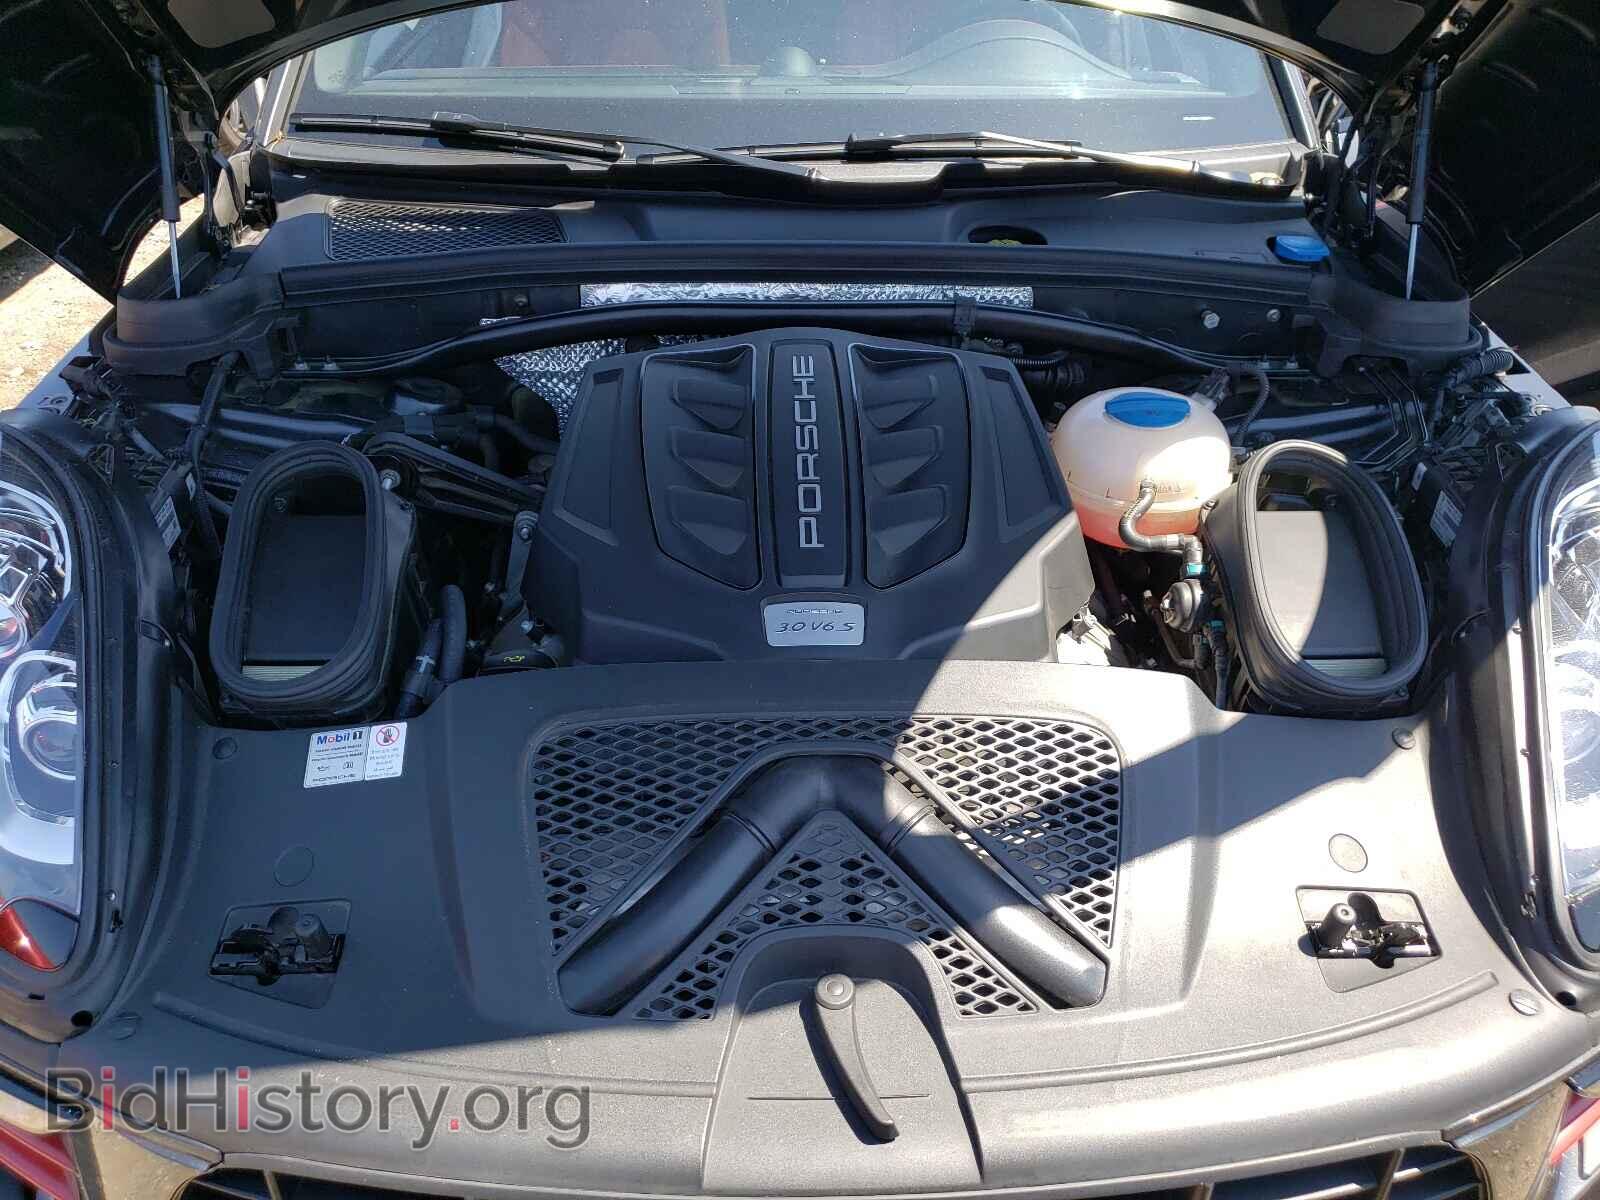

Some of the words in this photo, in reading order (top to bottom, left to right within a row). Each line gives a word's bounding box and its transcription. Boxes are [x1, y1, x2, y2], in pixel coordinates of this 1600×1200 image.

[792, 354, 824, 548] PORSCHE
[776, 622, 806, 633] 3.0
[811, 622, 834, 632] V6
[836, 622, 857, 632] S
[317, 732, 351, 745] Mobil
